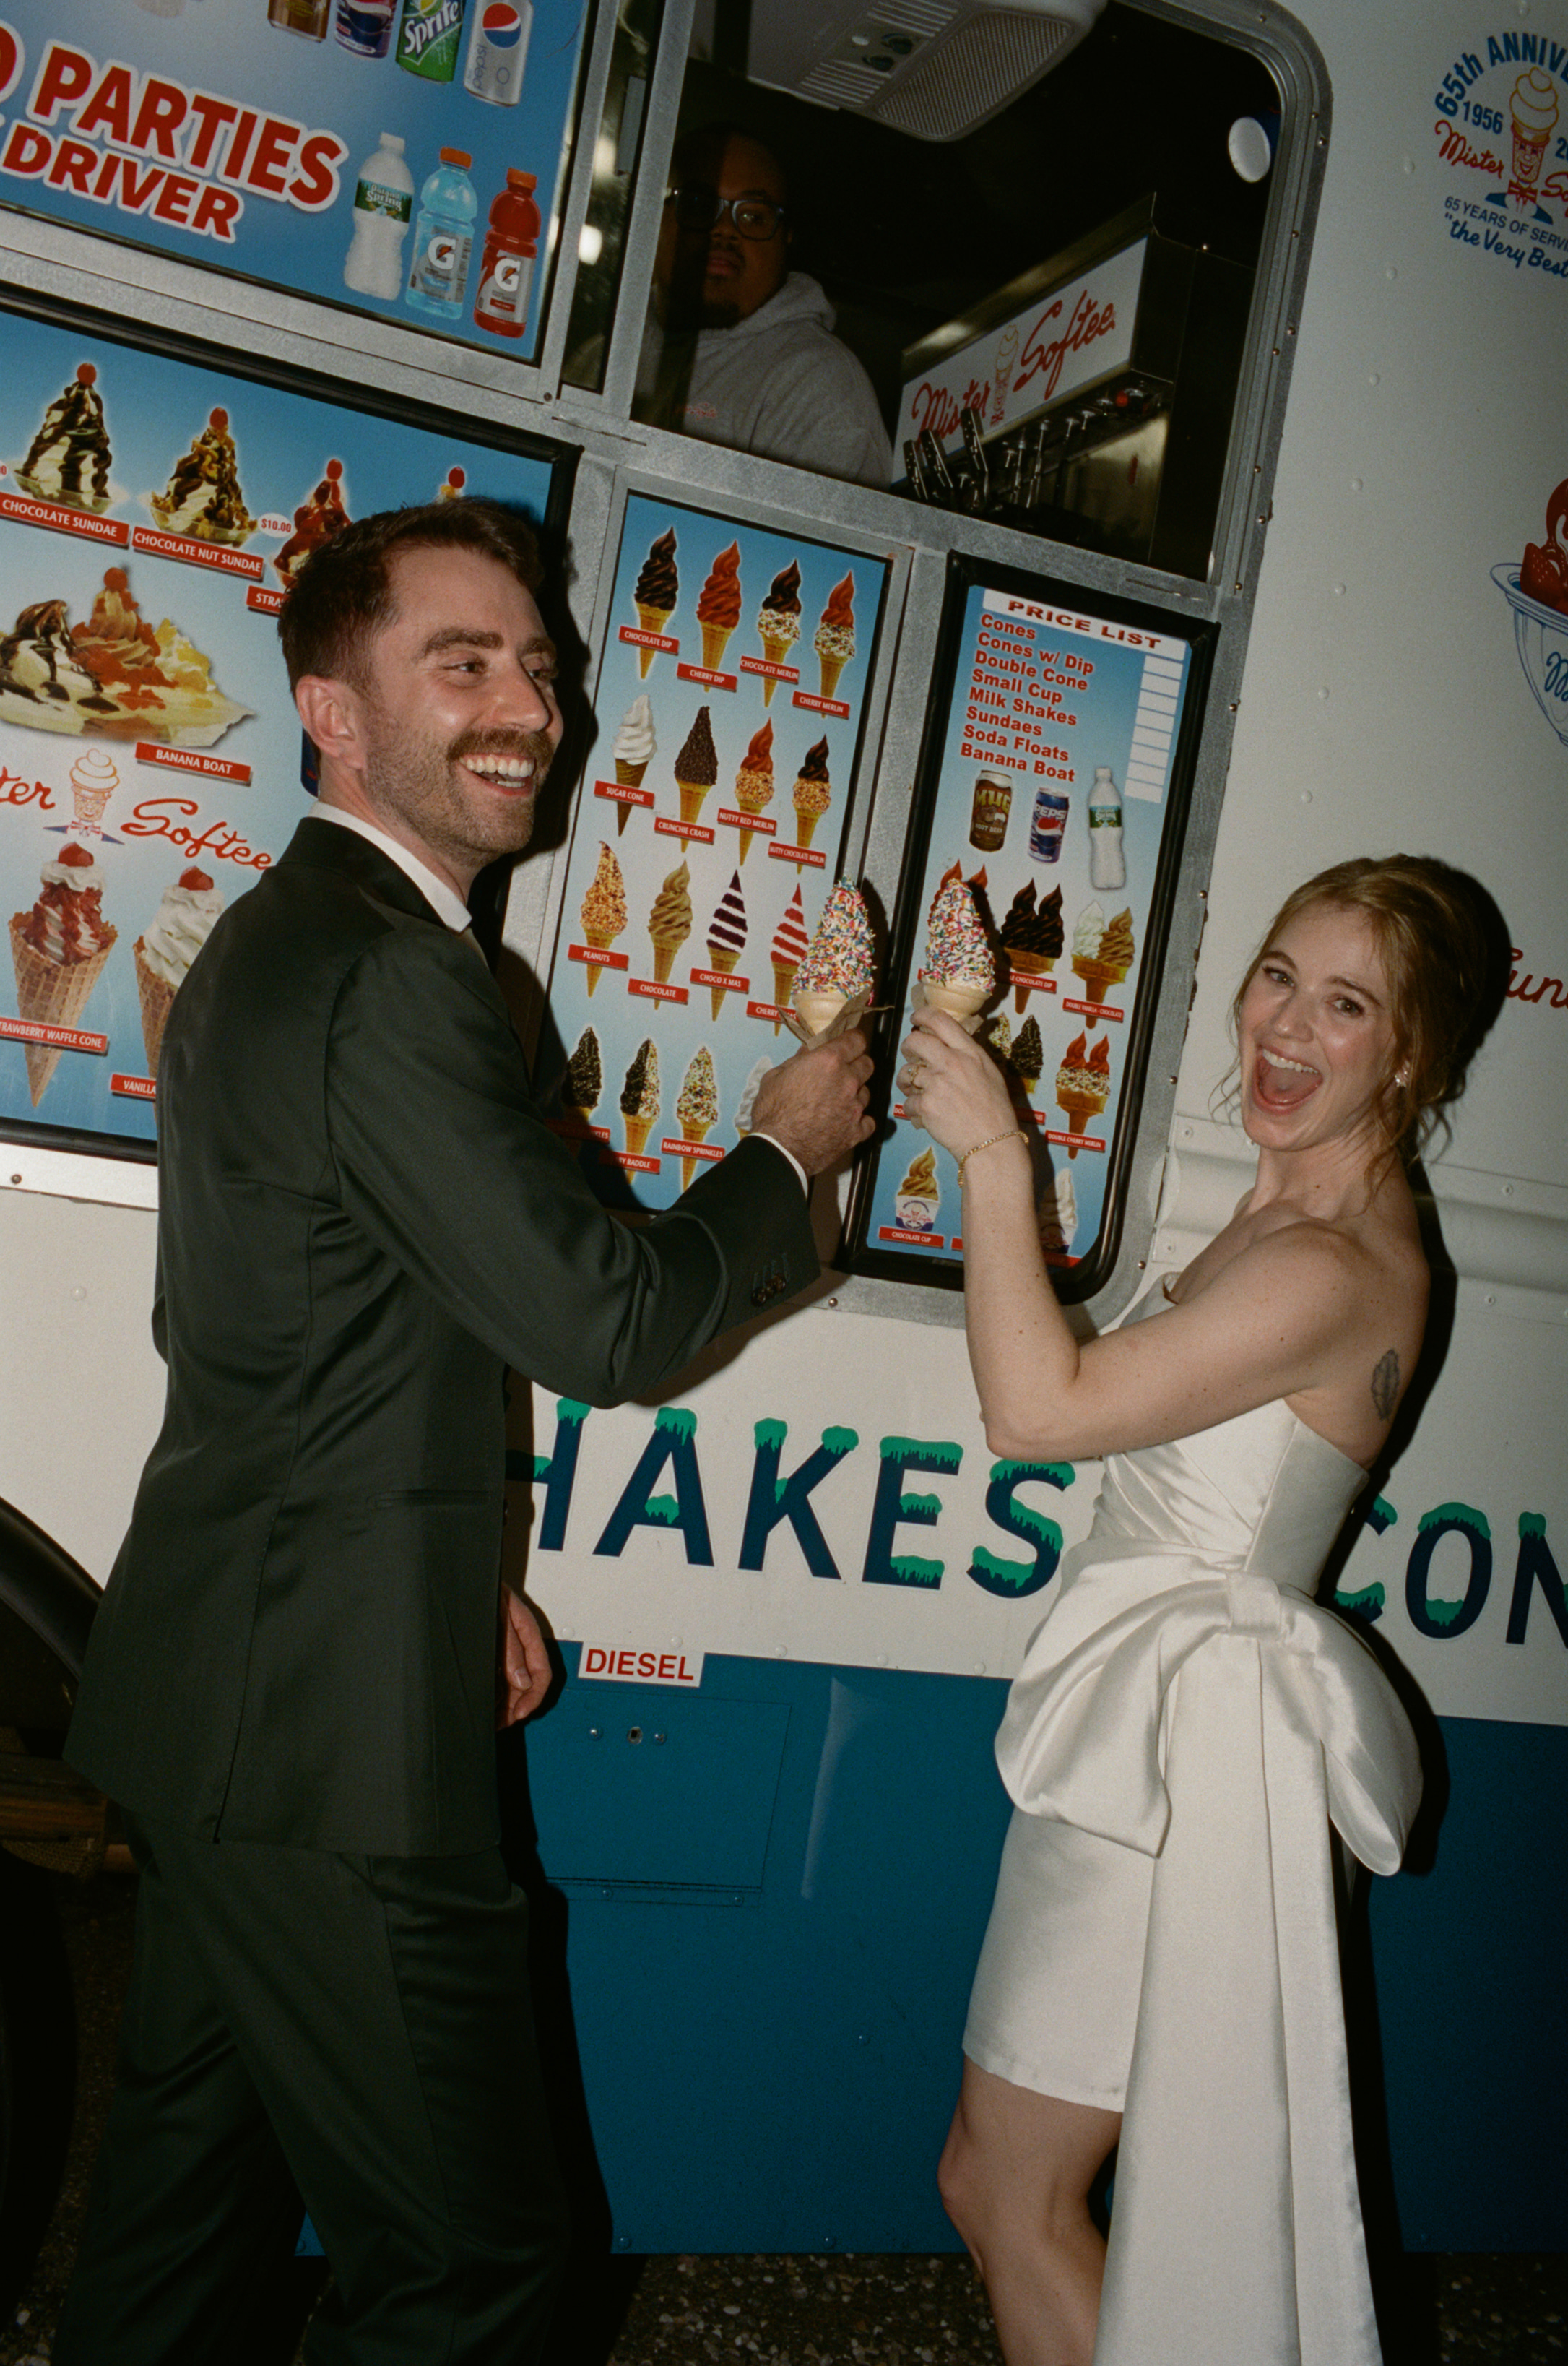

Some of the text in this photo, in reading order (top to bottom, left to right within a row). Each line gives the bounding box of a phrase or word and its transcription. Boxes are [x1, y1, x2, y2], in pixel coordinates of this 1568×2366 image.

[404, 1, 460, 56] Sprite
[473, 44, 488, 90] pepsi
[1435, 53, 1484, 117] 65th
[33, 45, 342, 205] PARTIES
[1463, 100, 1504, 135] 1956
[1435, 119, 1504, 178] Mister
[2, 124, 240, 238] DRIVER
[365, 191, 402, 211] Spring
[1444, 196, 1461, 212] 65
[1463, 201, 1507, 229] YEARS
[1509, 219, 1529, 236] OF
[428, 236, 457, 270] G
[1483, 228, 1525, 269] Very
[494, 258, 521, 292] G
[1013, 289, 1116, 401] Softee
[2, 499, 117, 537] CHOCOLATE SUNDAE
[261, 518, 292, 533] $10.00
[134, 532, 261, 572] CHOCOLATE NUT SUNDAE
[256, 593, 285, 608] STRA
[981, 613, 1036, 639] Cones
[1008, 600, 1161, 649] PRICE LIST
[624, 631, 672, 648] CHOCOLATE DIP
[978, 631, 1094, 675] Cones w/ Dip
[690, 669, 725, 683] CHERRY DIP
[740, 659, 799, 679] CHOCOLATE MERLIN
[975, 649, 1088, 691] Double Cone
[972, 668, 1062, 705] Small Cup
[800, 696, 844, 713] CHERRY MERLIN
[969, 686, 1077, 726] Milk Shakes
[966, 705, 1042, 737] Sundaes
[963, 724, 1070, 762] Soda Floats
[155, 749, 233, 775] BANANA BOAT
[960, 742, 1075, 782] Banana Boat
[606, 787, 644, 802] SUGAR CONE
[976, 788, 1010, 815] MUG
[121, 798, 276, 871] Softee
[658, 821, 710, 839] CRUNCHIE CRASH
[719, 812, 775, 831] NUTTY RED MERLIN
[784, 848, 808, 860] CHOCOLATE
[583, 950, 610, 963] PEANUTS
[640, 984, 676, 998] CHOCOLATE
[699, 973, 722, 984] CHOCO
[728, 978, 742, 988] MAS
[1015, 976, 1044, 988] CHOCOLATE
[755, 1006, 779, 1017] CHERRY
[47, 1029, 77, 1044] WAFFLE
[79, 1035, 103, 1048] CONE
[124, 1079, 156, 1095] VANILLA
[663, 1141, 723, 1158] RAINBOW SPRINKLES
[1047, 1133, 1101, 1149] DOUBLE CHERRY MERLIN
[627, 1157, 651, 1169] RADDLE
[891, 1231, 921, 1241] CHOCOLATE
[584, 1649, 695, 1682] DIESEL
